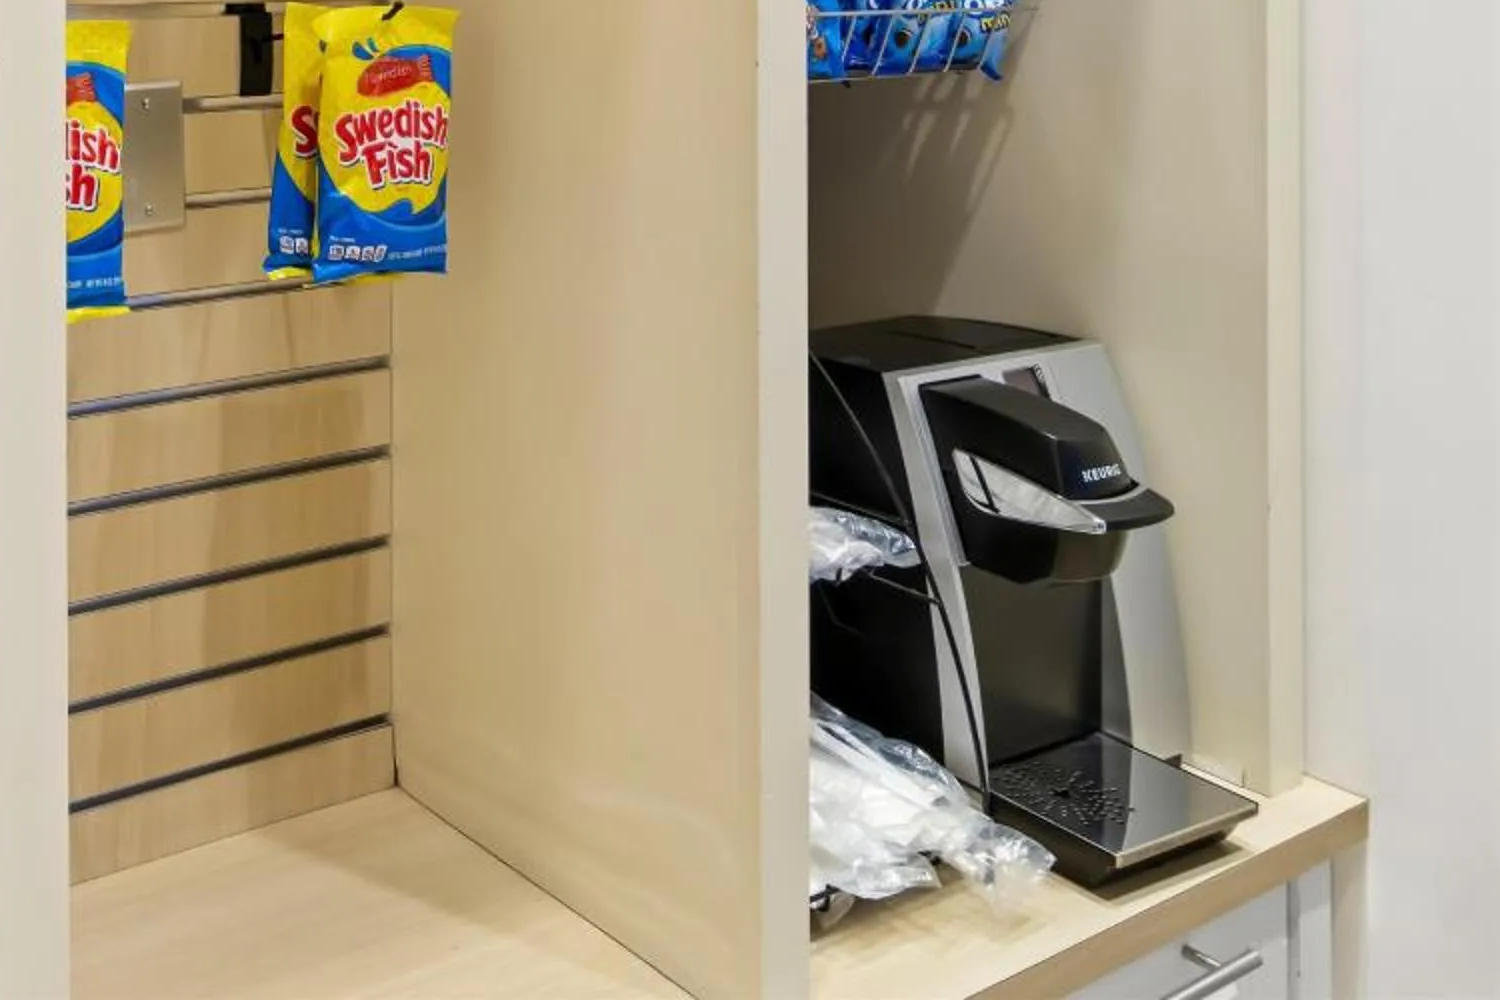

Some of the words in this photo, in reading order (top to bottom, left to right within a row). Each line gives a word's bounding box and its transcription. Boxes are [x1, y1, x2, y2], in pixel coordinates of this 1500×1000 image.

[334, 101, 448, 164] Swedish
[362, 141, 433, 190] Fish
[1081, 463, 1121, 483] KEURIG
